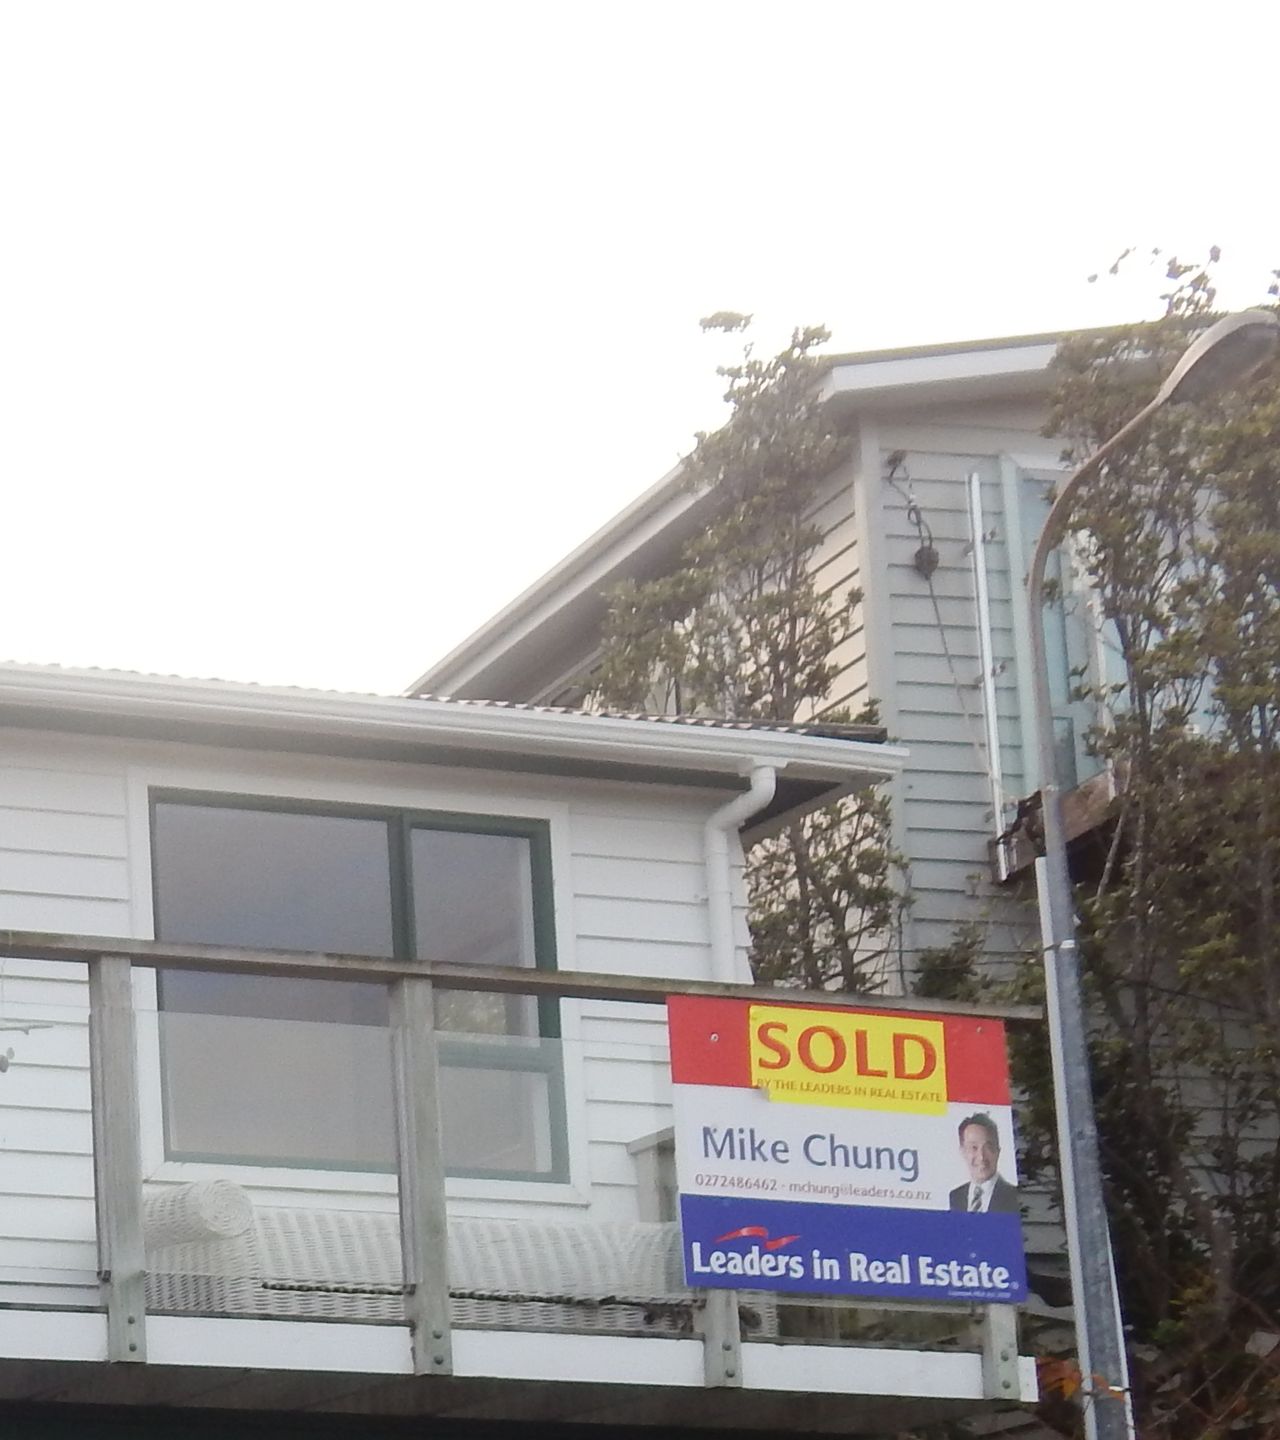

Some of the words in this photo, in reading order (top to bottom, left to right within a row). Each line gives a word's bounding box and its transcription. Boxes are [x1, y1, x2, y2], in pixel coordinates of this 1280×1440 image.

[756, 1021, 938, 1081] SOLD
[757, 1078, 772, 1088] BY
[775, 1079, 796, 1091] THE
[800, 1081, 851, 1096] LEADERS
[855, 1086, 867, 1096] IN
[870, 1087, 897, 1100] REAL
[900, 1090, 942, 1103] ESTATE
[701, 1125, 790, 1164] Mike
[803, 1133, 920, 1183] Chung
[694, 1172, 777, 1192] 0272486462
[789, 1179, 932, 1201] mchung@leaders.co.nz
[692, 1241, 804, 1277] Leaders
[813, 1249, 840, 1281] in
[850, 1252, 910, 1285] Real
